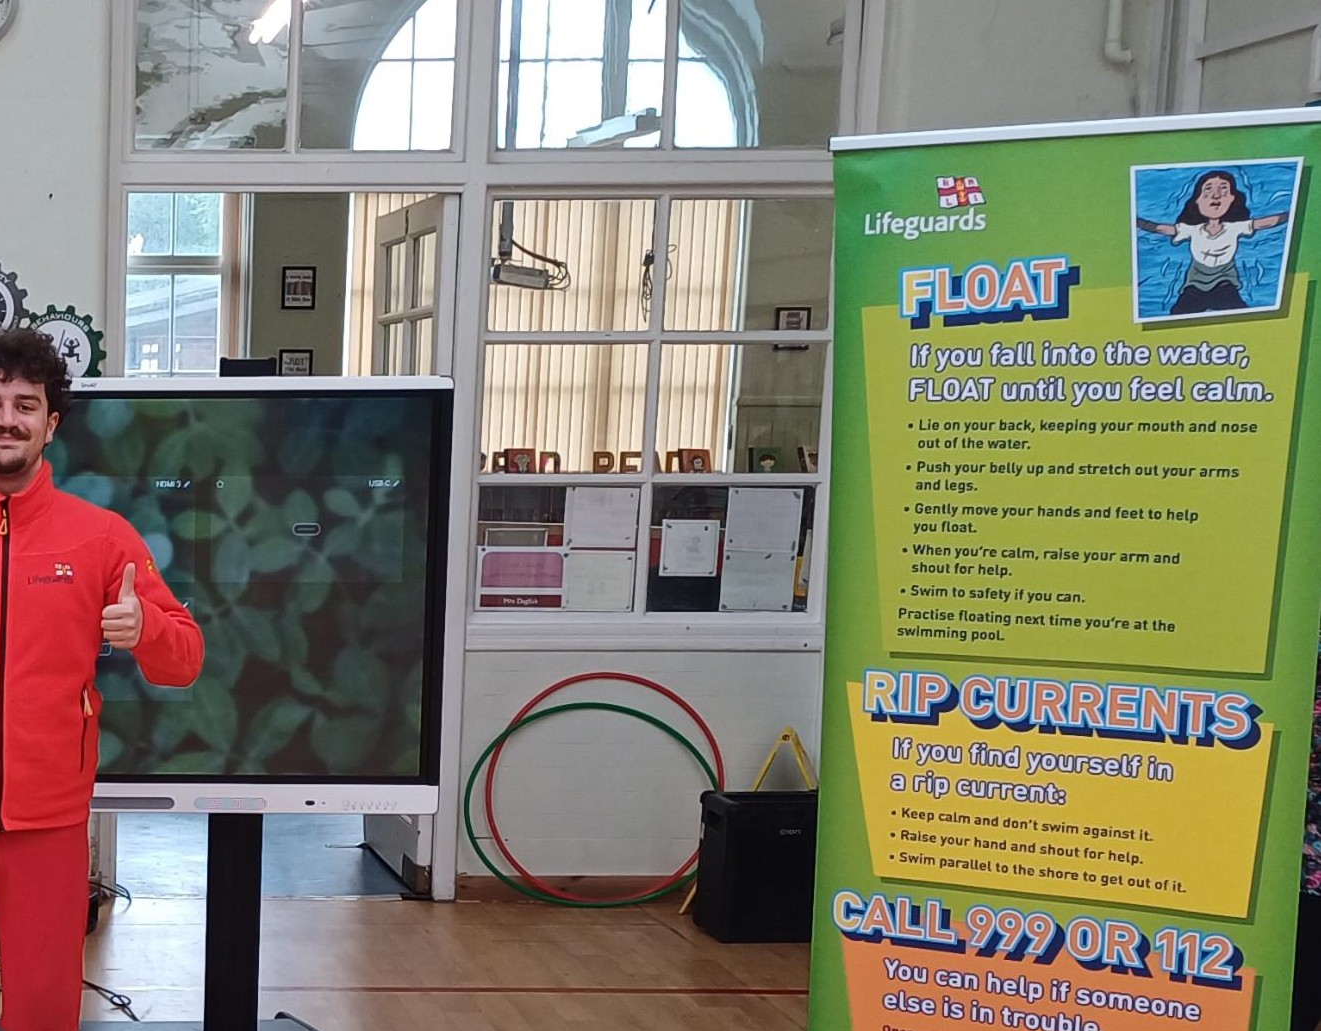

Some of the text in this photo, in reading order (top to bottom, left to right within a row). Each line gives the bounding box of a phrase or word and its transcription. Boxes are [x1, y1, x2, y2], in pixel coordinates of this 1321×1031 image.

[863, 208, 987, 239] Lifeguards
[899, 256, 1073, 320] FLOAT
[30, 313, 90, 332] BEHAVIOURS
[910, 340, 1248, 372] If you fall into the water,
[909, 375, 1272, 406] FLOAT until you feel calm.
[918, 418, 1257, 434] Lie on your back, keeping your mouth and nose
[863, 672, 1255, 741] RIP CURRENTS
[892, 737, 1172, 781] If you find yourself in
[890, 773, 1068, 806] a rip current:
[900, 829, 1143, 866] Raise your hand and shout for help.
[833, 891, 1234, 982] CALL 999 OR 112
[883, 958, 1200, 1021] You can help if someone
[883, 991, 935, 1014] else
[942, 999, 963, 1019] is
[970, 1003, 993, 1024] in
